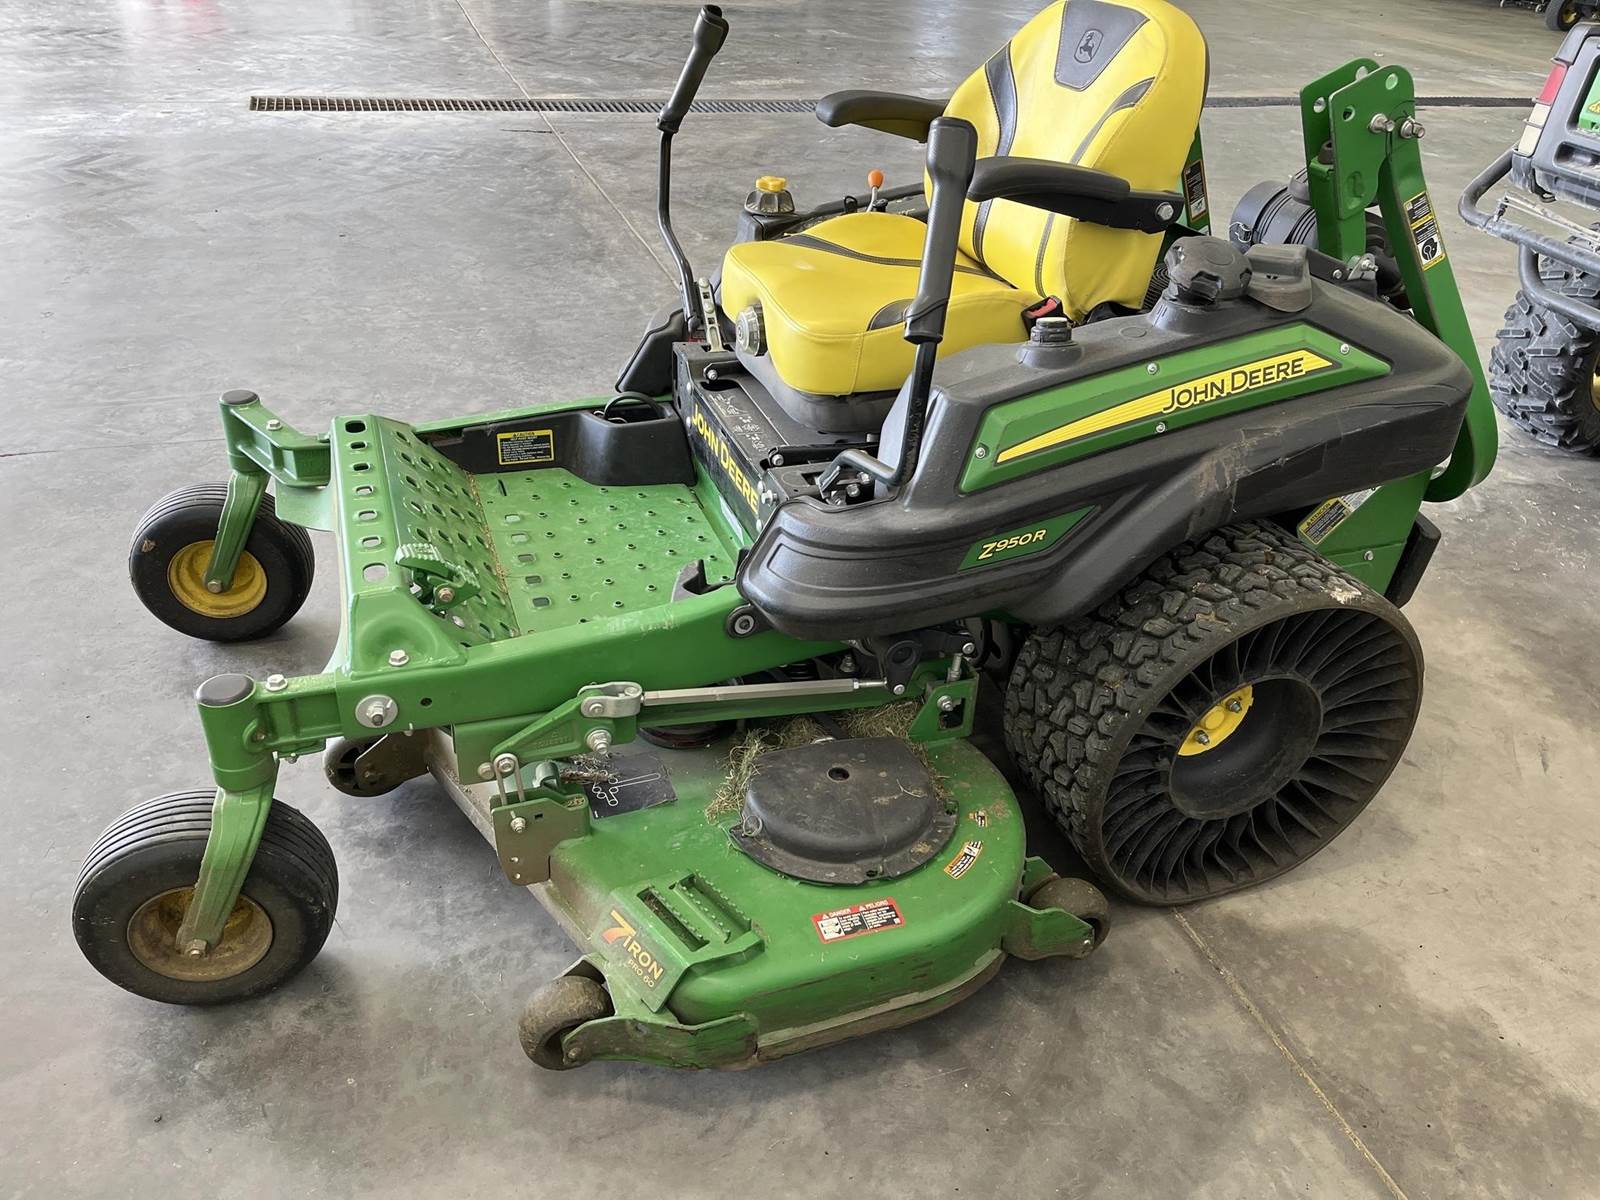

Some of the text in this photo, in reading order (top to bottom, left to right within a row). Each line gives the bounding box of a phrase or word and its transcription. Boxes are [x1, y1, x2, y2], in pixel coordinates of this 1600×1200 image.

[1162, 357, 1304, 412] JOHN DEERE
[692, 403, 759, 515] JOHN DEERE
[978, 529, 1047, 560] Z950R
[828, 908, 852, 918] DANGER
[627, 959, 644, 976] PRO
